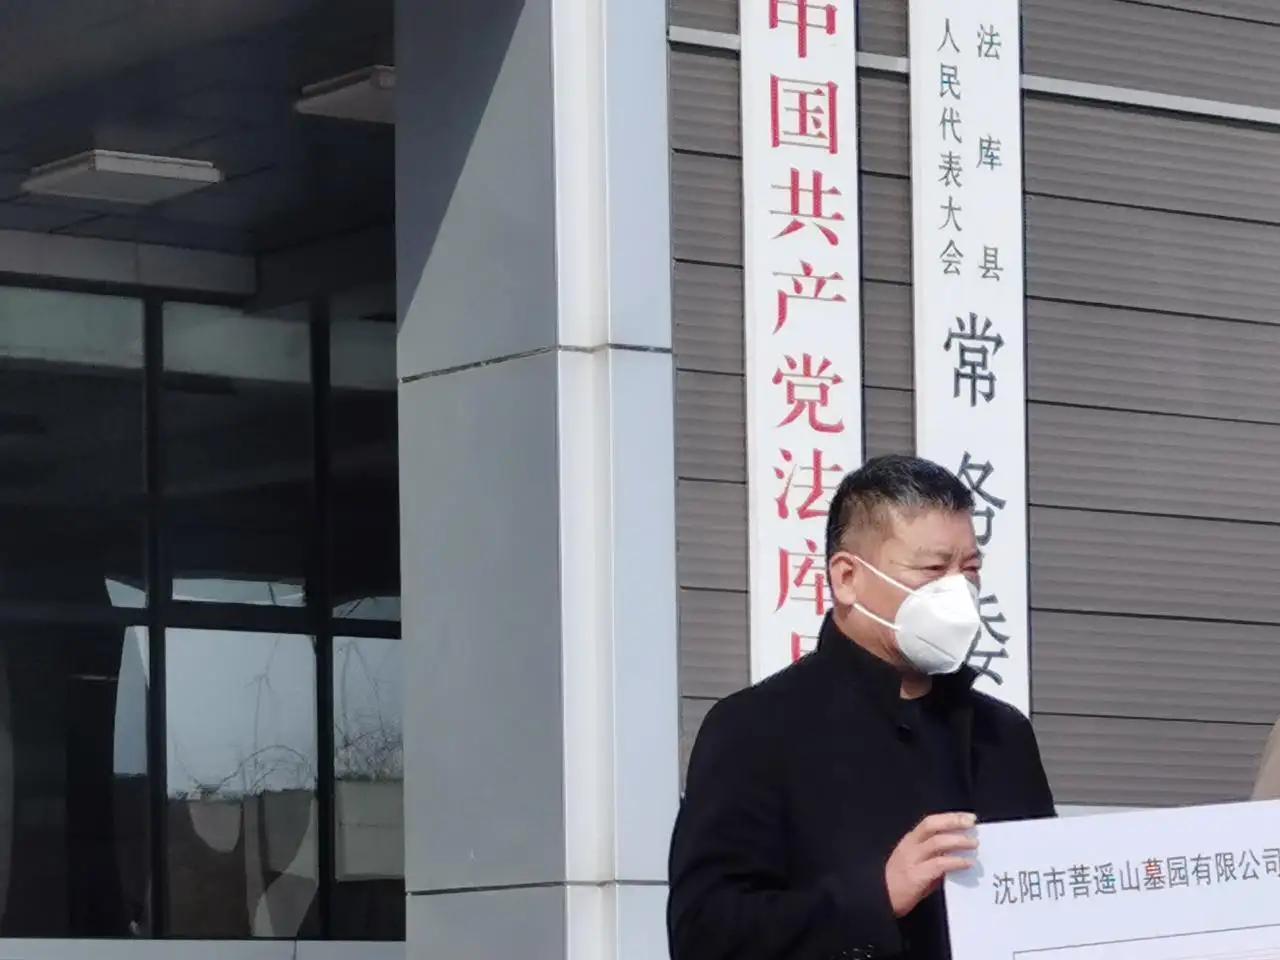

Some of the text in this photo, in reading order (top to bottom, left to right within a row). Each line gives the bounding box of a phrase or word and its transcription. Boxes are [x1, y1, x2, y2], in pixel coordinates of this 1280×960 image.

[938, 18, 964, 277] 人民代表大会
[976, 24, 1004, 281] 法库县
[768, 0, 847, 663] 中国共产党法库
